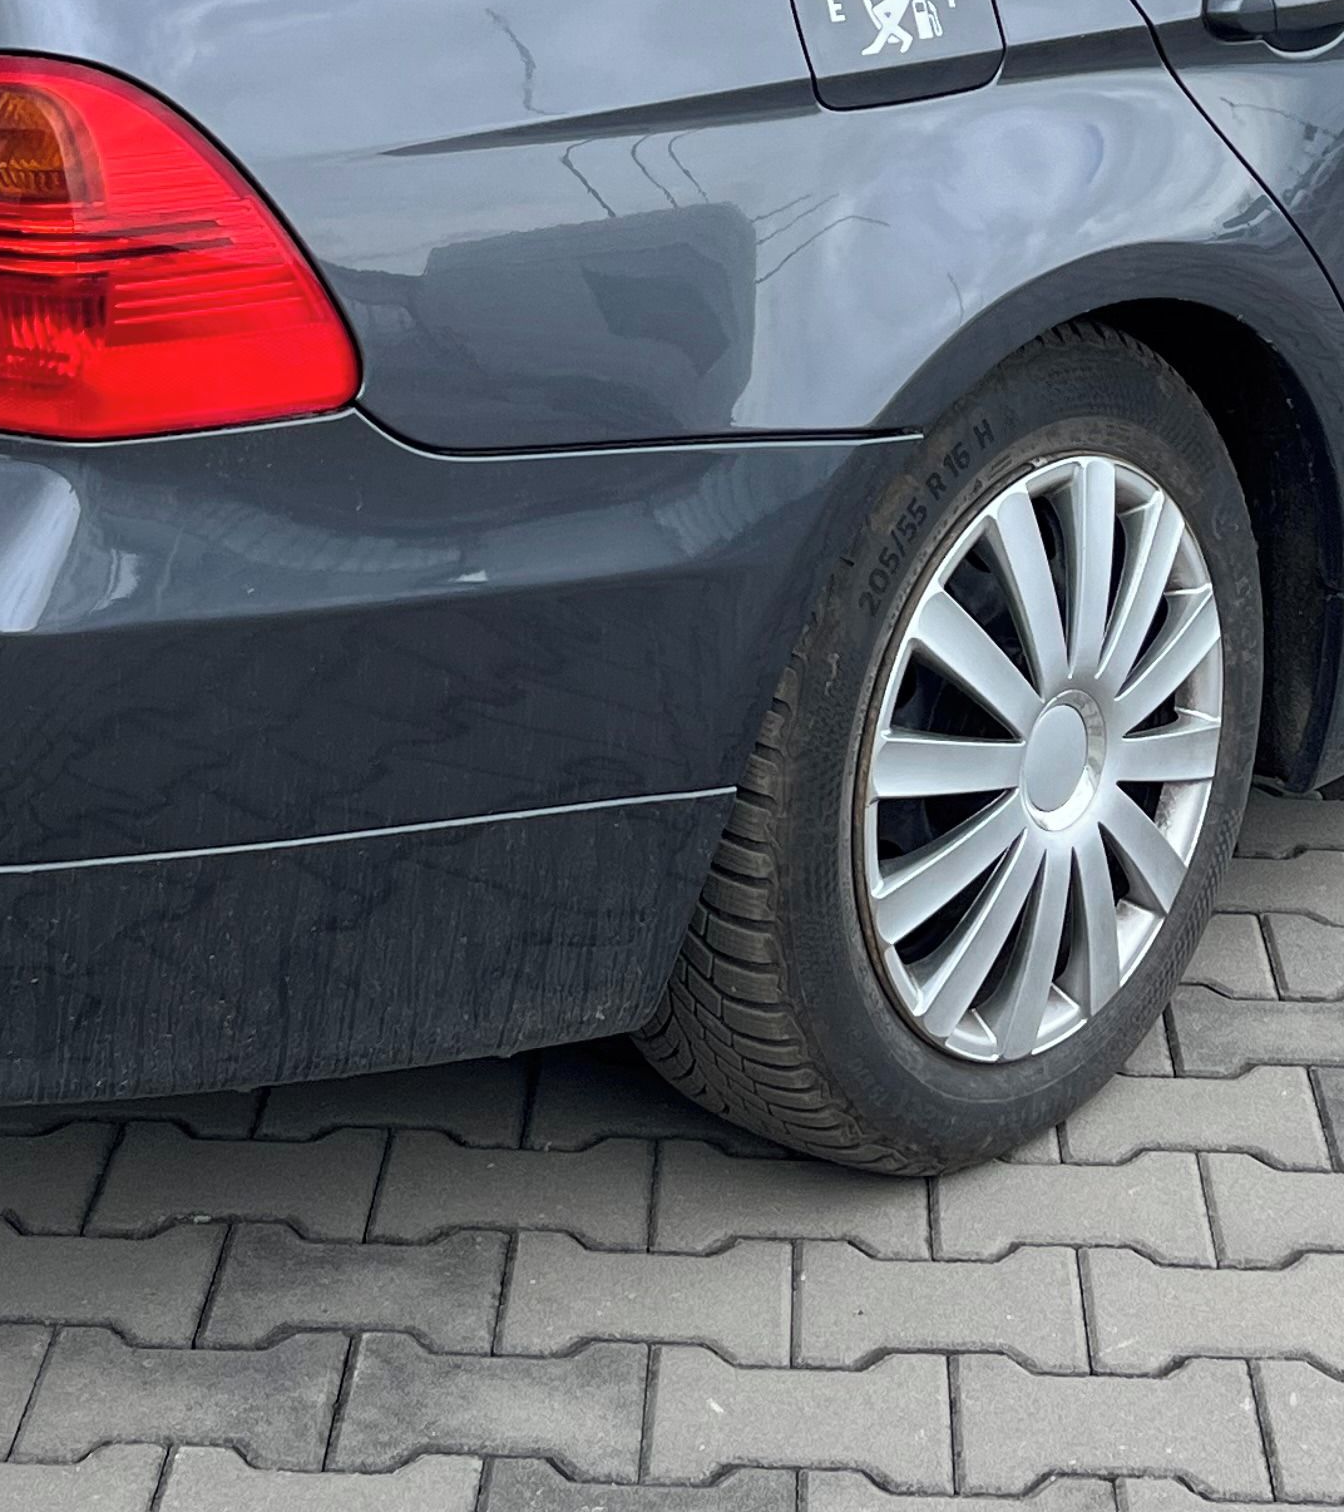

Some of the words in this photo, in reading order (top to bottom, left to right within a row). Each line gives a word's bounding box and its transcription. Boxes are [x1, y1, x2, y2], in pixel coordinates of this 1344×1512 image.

[859, 497, 928, 617] 205/55
[925, 472, 947, 502] R
[943, 441, 971, 479] 16
[972, 418, 995, 449] H
